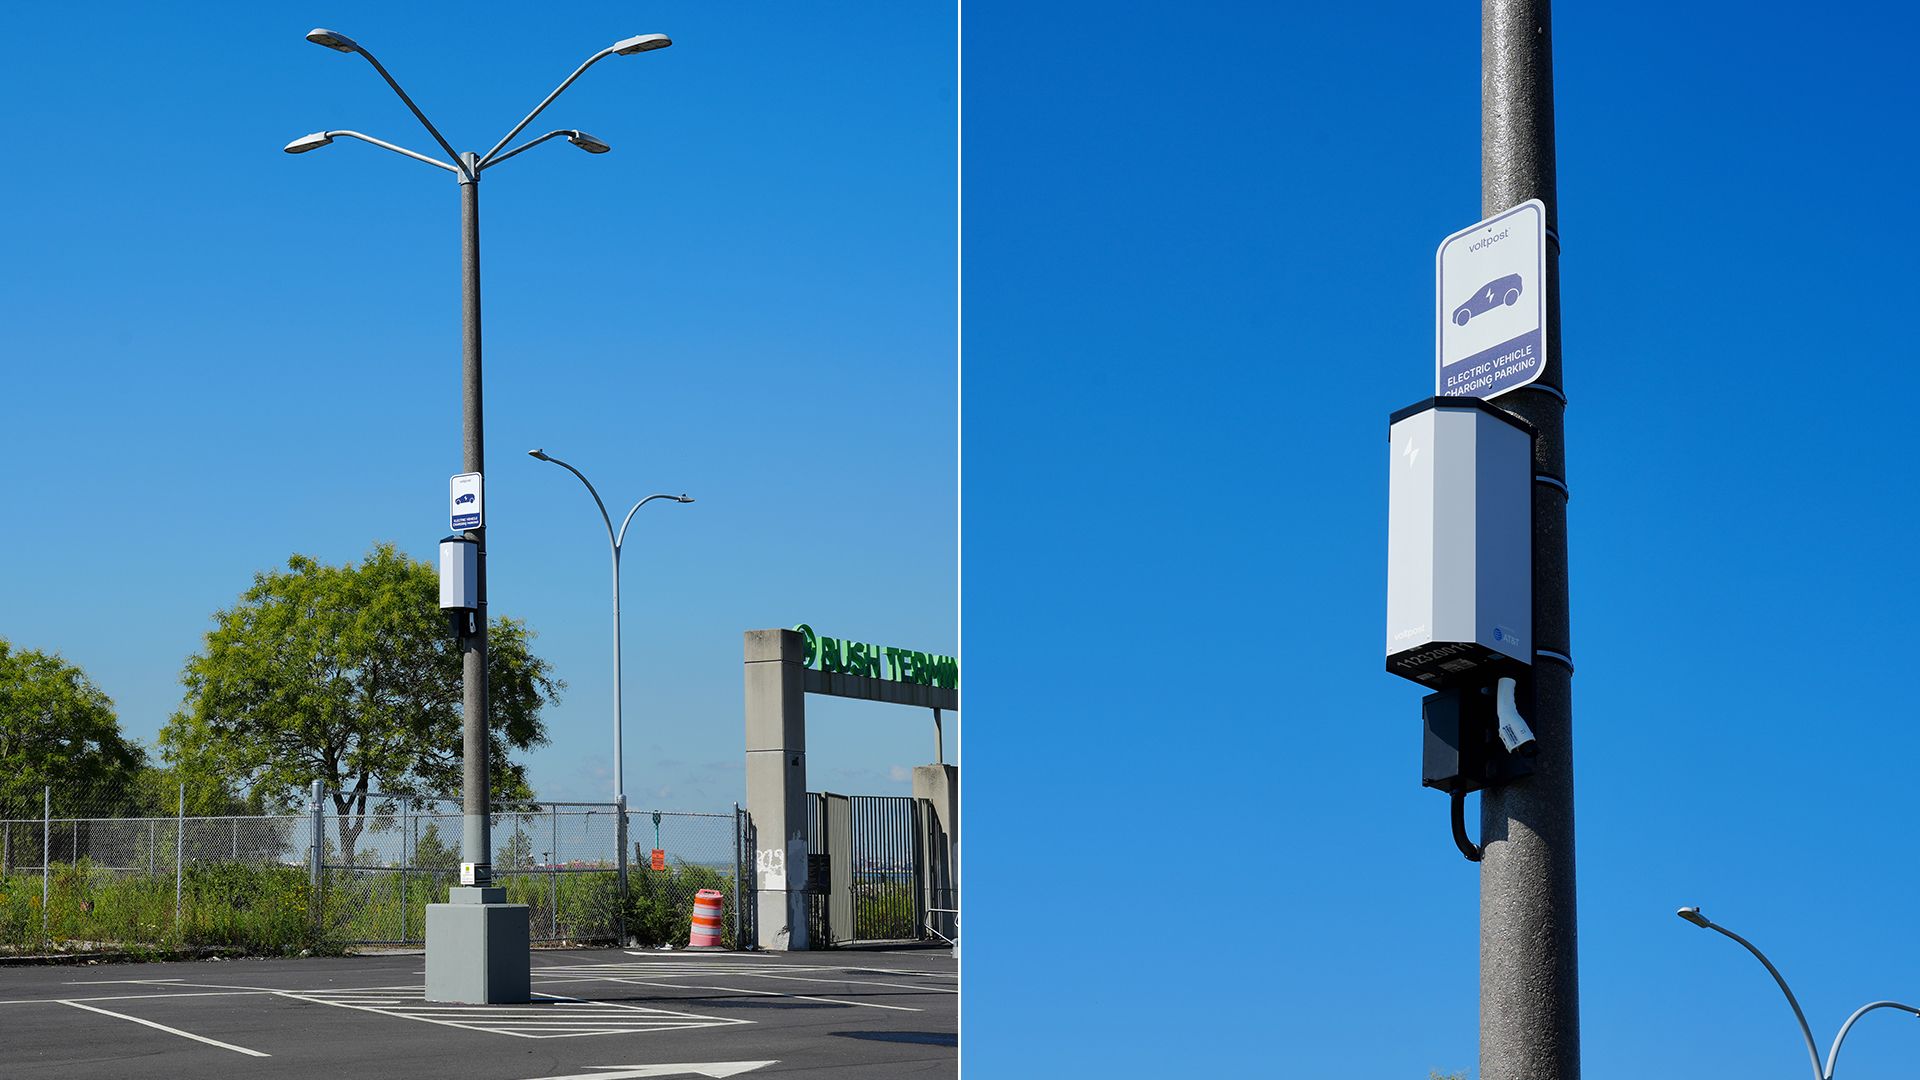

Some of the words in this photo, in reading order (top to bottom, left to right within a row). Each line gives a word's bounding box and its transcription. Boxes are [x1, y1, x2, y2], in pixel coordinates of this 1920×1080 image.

[1469, 229, 1509, 253] voltpost
[1447, 363, 1491, 386] ELECTRIC
[1493, 345, 1532, 370] VEHICLE
[1495, 357, 1535, 382] PARKING
[817, 636, 882, 679] BUSH
[1397, 642, 1474, 669] 112320011
